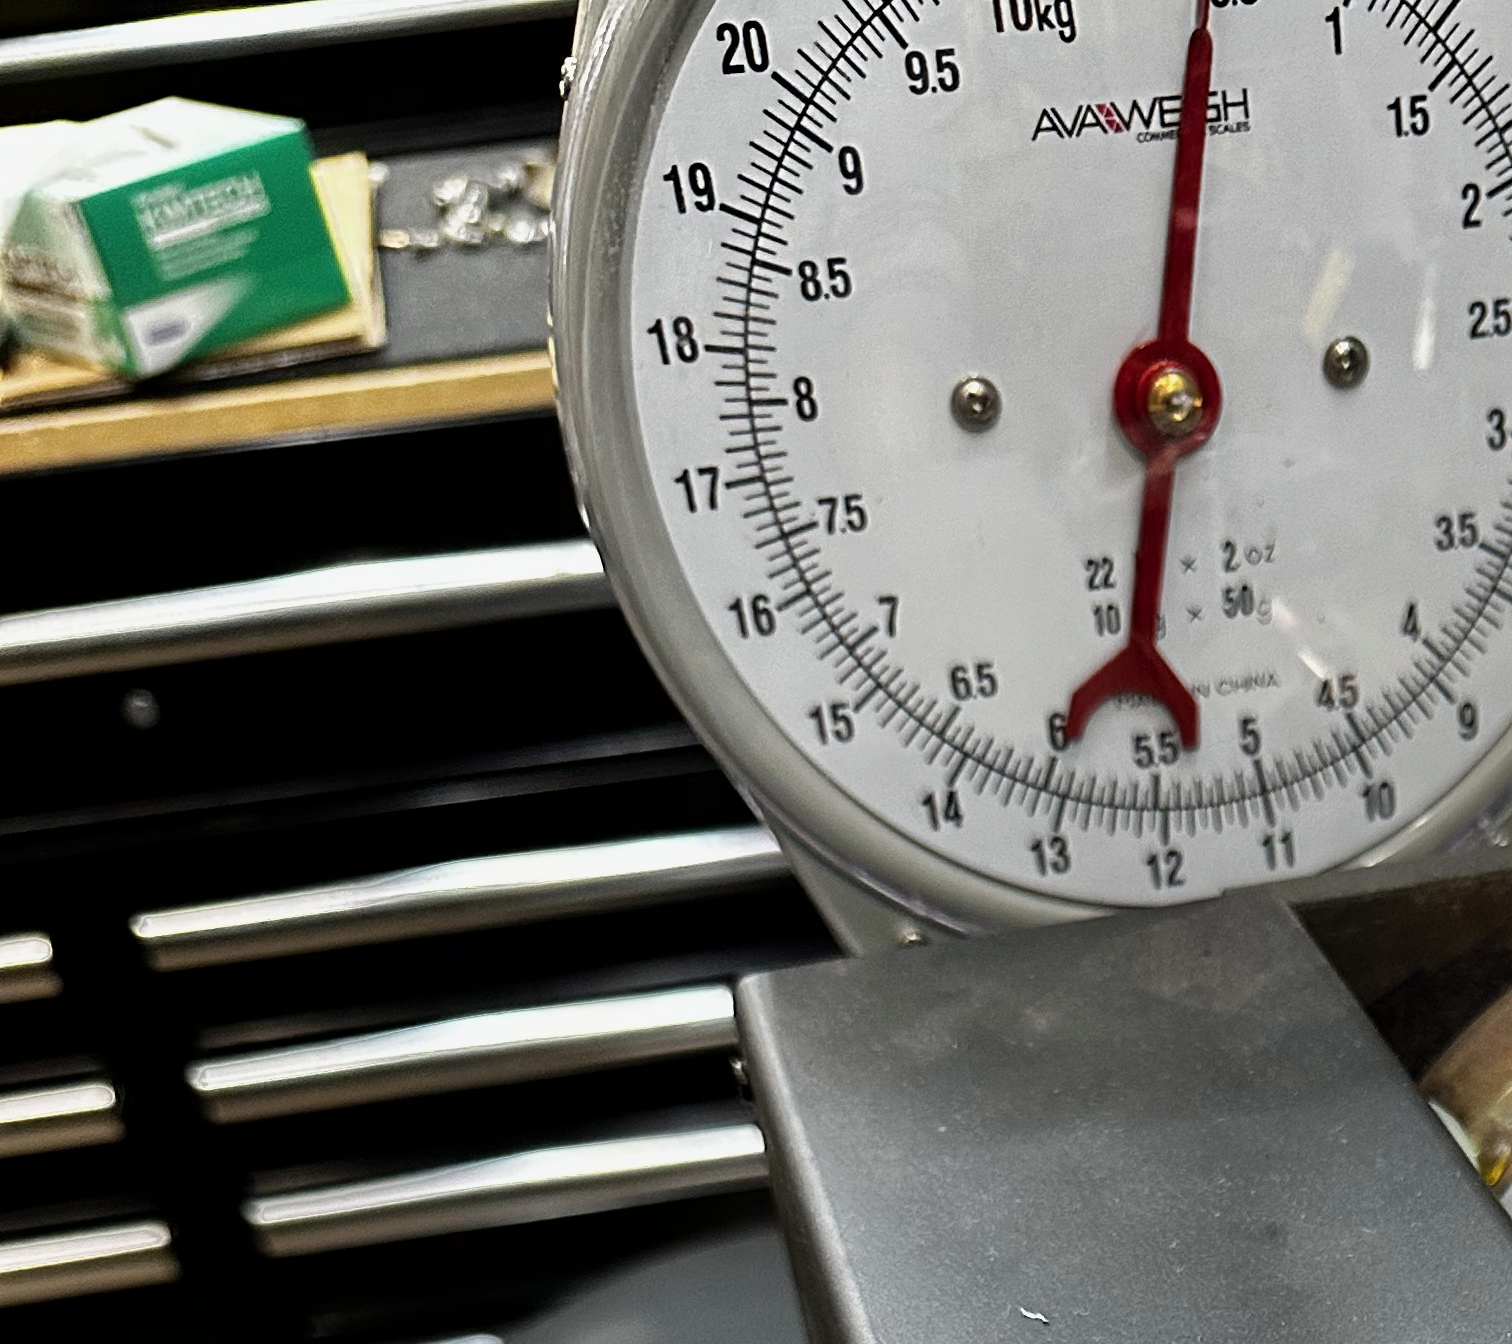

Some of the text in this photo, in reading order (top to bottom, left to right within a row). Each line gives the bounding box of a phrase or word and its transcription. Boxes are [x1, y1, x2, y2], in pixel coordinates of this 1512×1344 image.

[716, 21, 769, 74] 20
[1325, 7, 1342, 55] 1
[905, 49, 960, 95] 9.5
[1032, 88, 1250, 141] AVAWEGH
[1387, 95, 1430, 137] 1.5
[662, 162, 717, 212] 19
[839, 147, 863, 194] 9
[1462, 184, 1481, 228] 2
[800, 259, 852, 301] 8.5
[647, 317, 699, 364] 18
[793, 377, 818, 421] 8
[1486, 410, 1507, 450] 3
[674, 467, 718, 513] 17
[818, 493, 868, 535] 7.5
[1086, 557, 1116, 591] 22
[728, 595, 776, 639] 16
[878, 595, 898, 638] 7
[1094, 603, 1121, 637] 10
[1402, 603, 1421, 641] 4
[808, 703, 855, 744] 15
[1049, 713, 1068, 750] 6
[1239, 715, 1261, 755] 5
[1457, 703, 1478, 740] 9
[922, 790, 962, 831] 14
[1362, 780, 1395, 822] 10
[1031, 835, 1071, 876] 13
[1147, 849, 1185, 889] 12
[1262, 831, 1295, 870] 11
